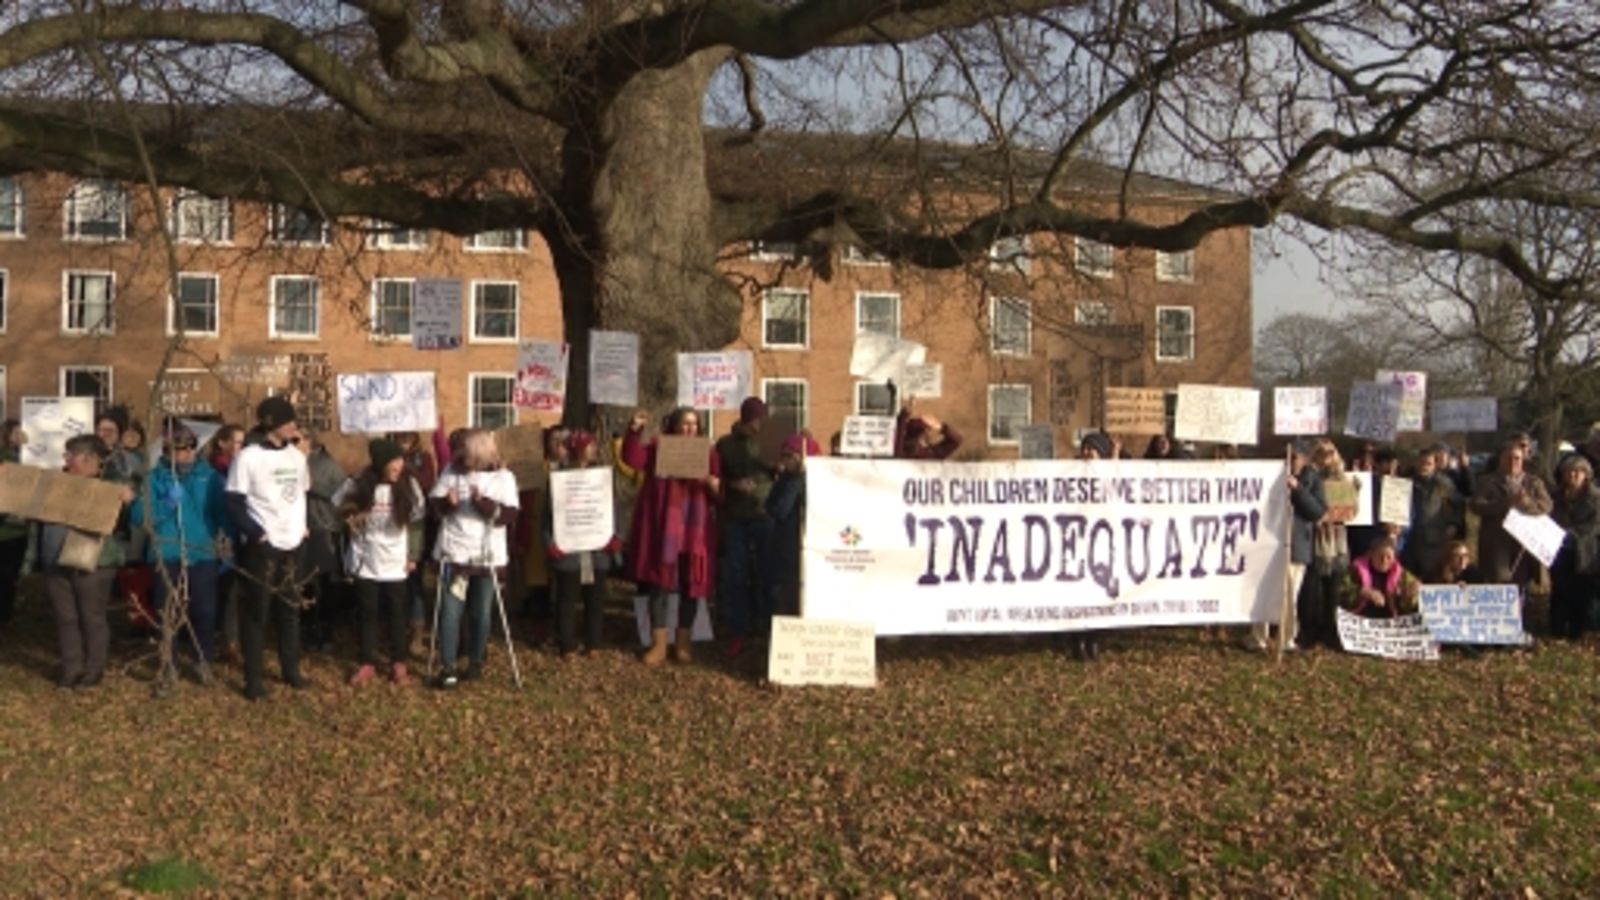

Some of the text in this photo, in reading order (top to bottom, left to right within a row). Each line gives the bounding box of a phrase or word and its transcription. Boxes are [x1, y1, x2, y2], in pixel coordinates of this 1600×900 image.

[903, 478, 945, 505] OUR
[949, 477, 1049, 504] CHILDREN
[1141, 477, 1210, 503] BETTER
[1216, 477, 1263, 502] THAN
[904, 508, 1260, 599] 'INADEQUATE'
